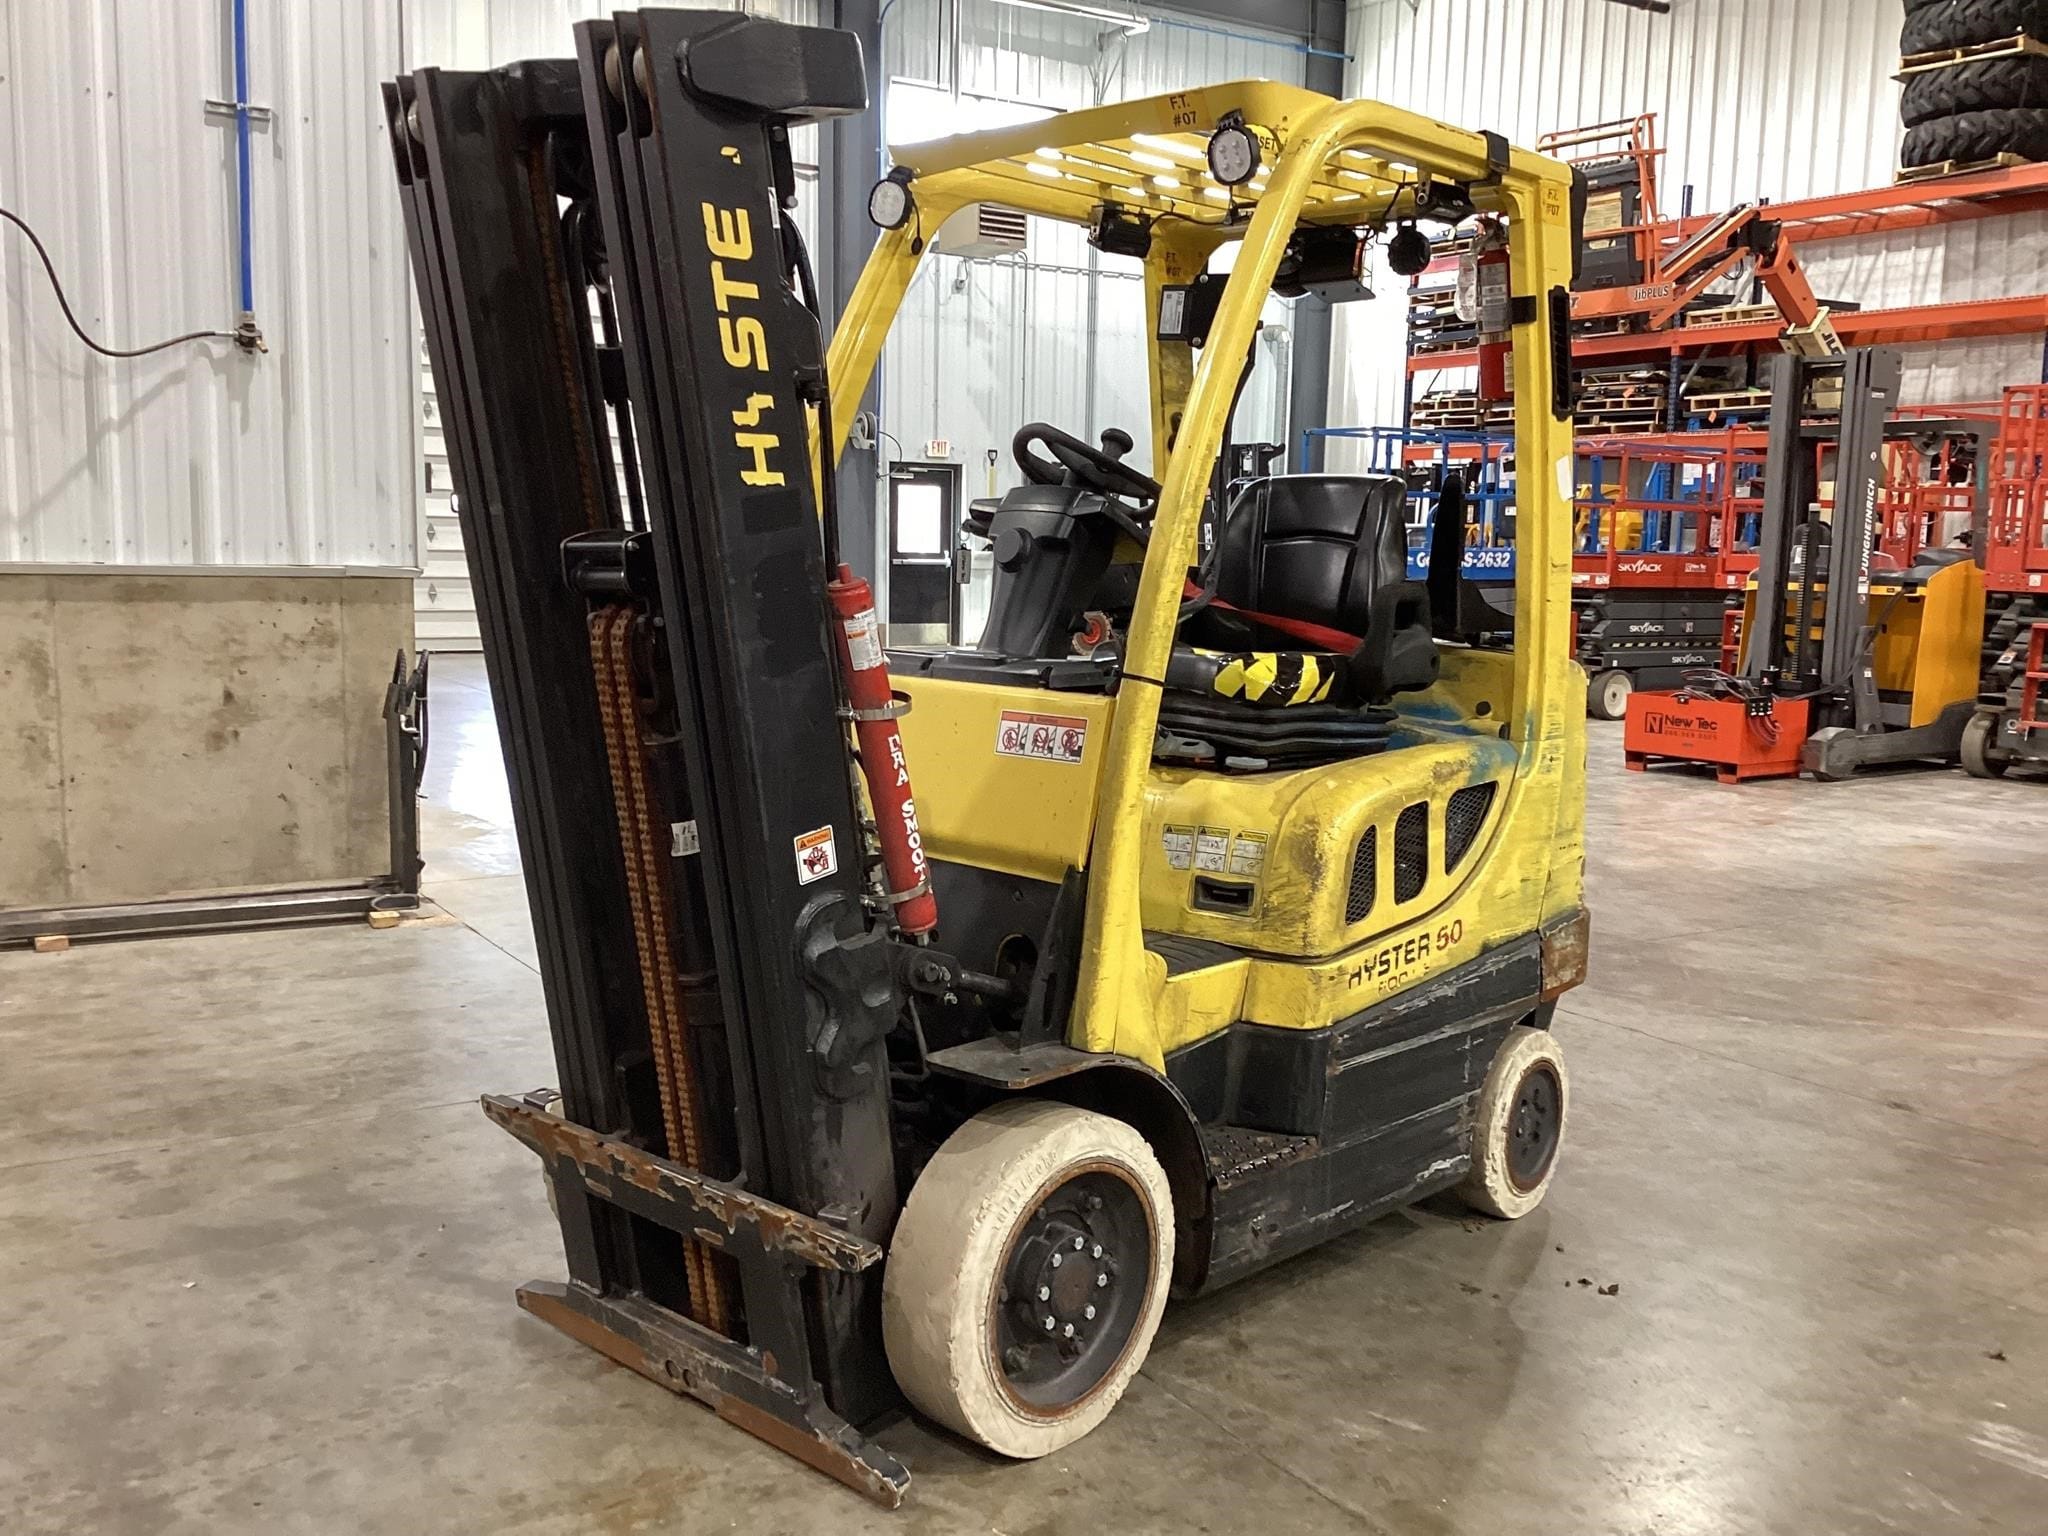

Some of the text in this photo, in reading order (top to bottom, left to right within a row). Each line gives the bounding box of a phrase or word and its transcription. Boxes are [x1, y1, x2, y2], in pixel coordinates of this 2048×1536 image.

[1169, 95, 1191, 109] F.T.
[1173, 112, 1197, 127] #07
[1633, 286, 1669, 300] JibPLUS
[931, 440, 948, 452] EXIT
[1860, 478, 1876, 577] JUNGHEINRICH
[1461, 551, 1511, 568] S-2632
[1618, 560, 1662, 574] SKYJACK
[1629, 622, 1664, 634] SKYJACK
[1664, 715, 1694, 728] New
[1696, 717, 1718, 730] Tec
[901, 799, 933, 894] SMOOT
[1348, 933, 1430, 990] HYSTER
[1436, 919, 1462, 951] 50
